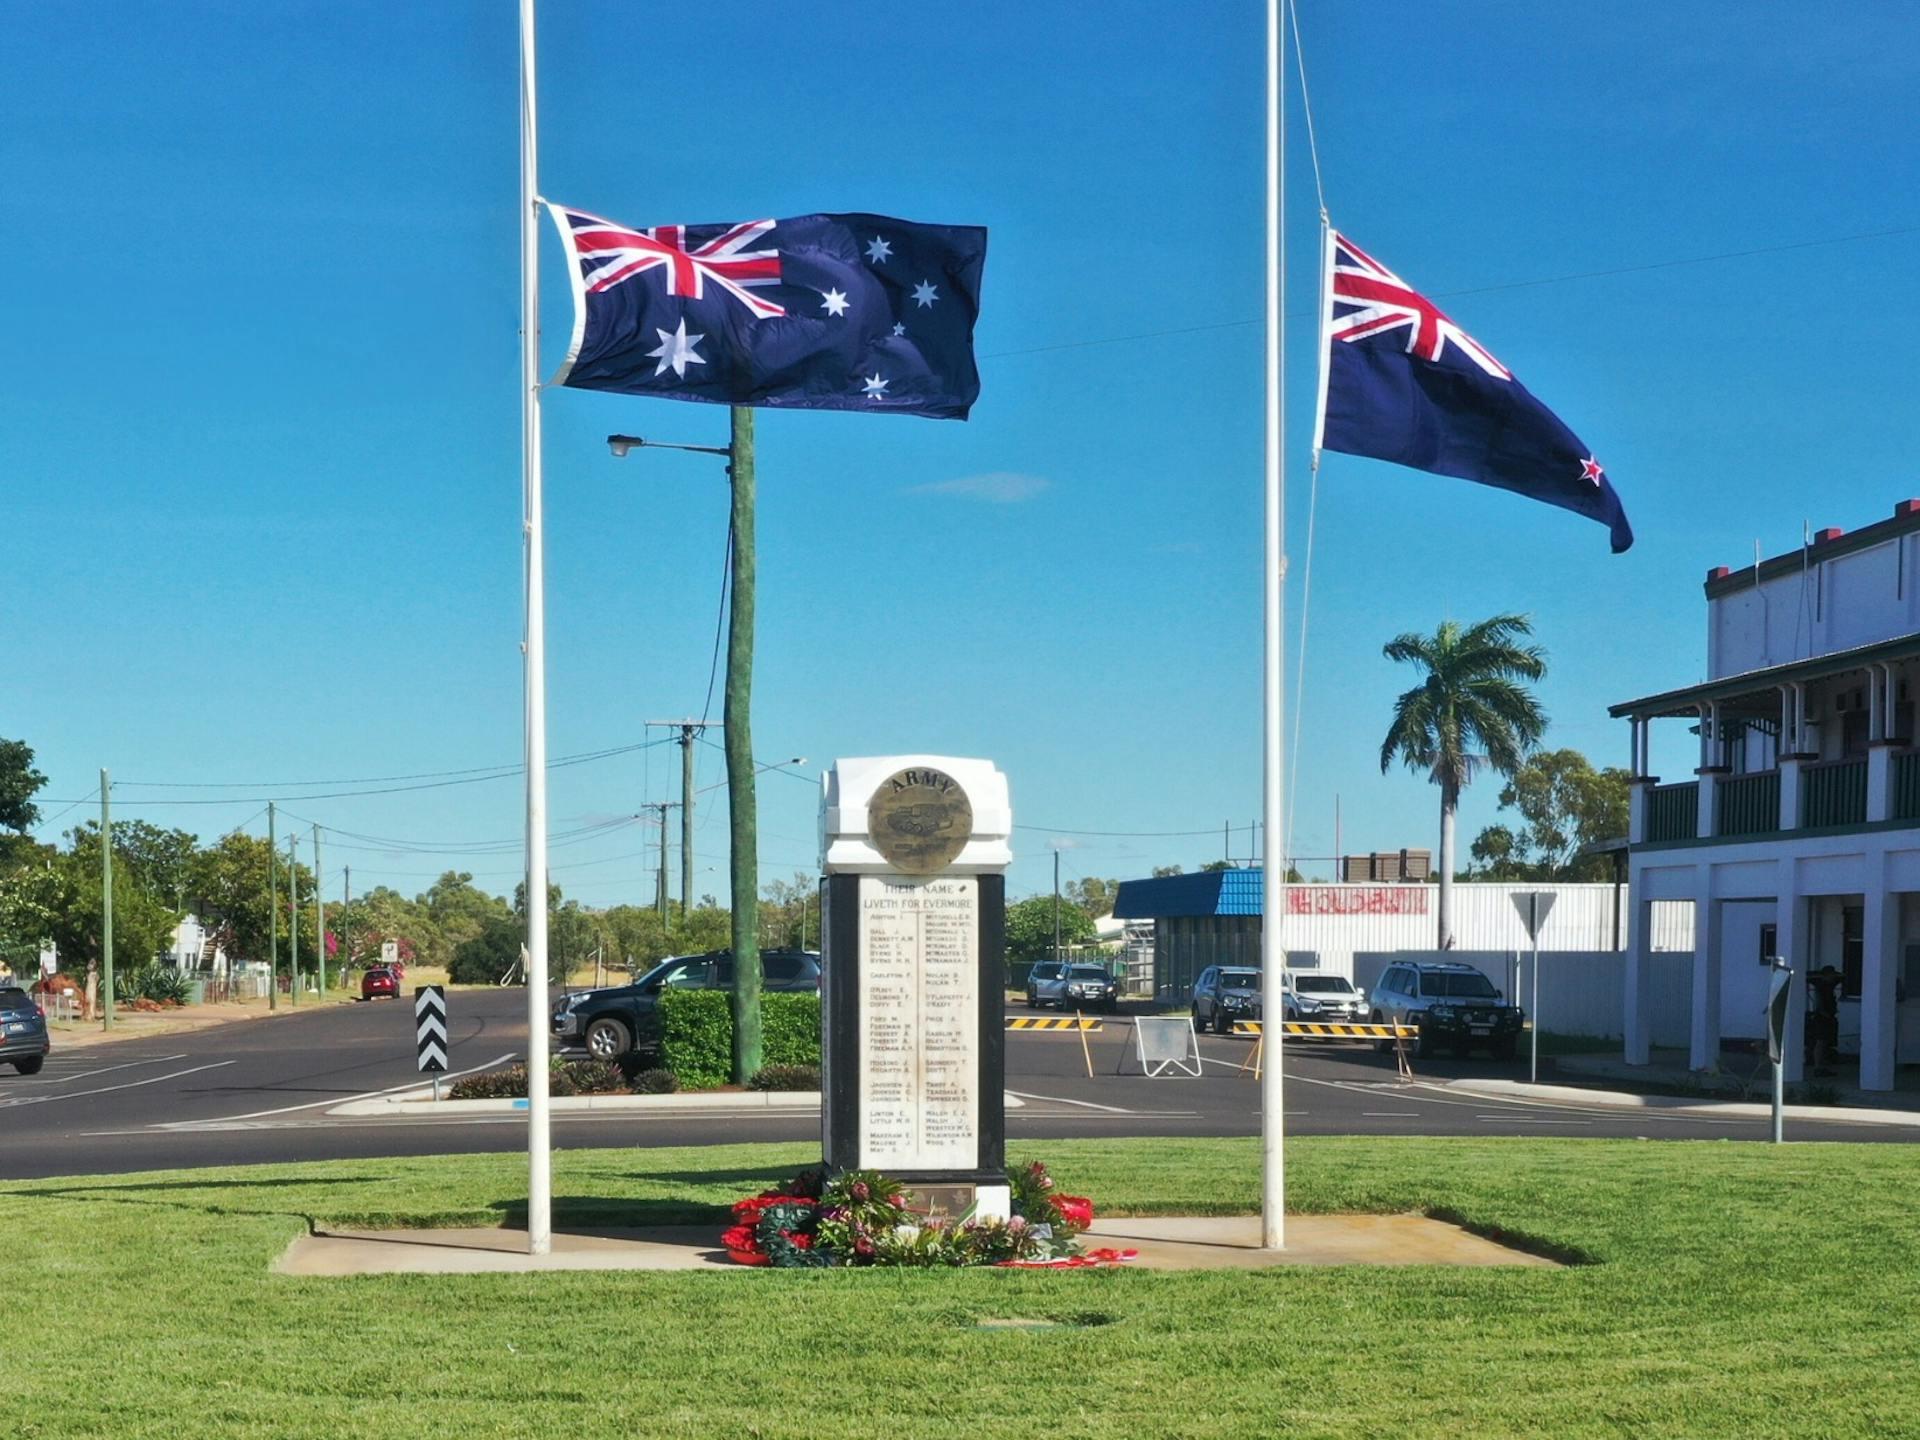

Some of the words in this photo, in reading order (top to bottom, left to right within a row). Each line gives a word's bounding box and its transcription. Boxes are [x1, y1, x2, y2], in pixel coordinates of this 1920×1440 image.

[890, 770, 955, 793] ARMY
[885, 884, 916, 894] THEIR
[922, 884, 954, 894] NAME
[864, 899, 898, 909] LIVETH
[901, 899, 920, 909] FOR
[923, 899, 973, 909] EVERMORE
